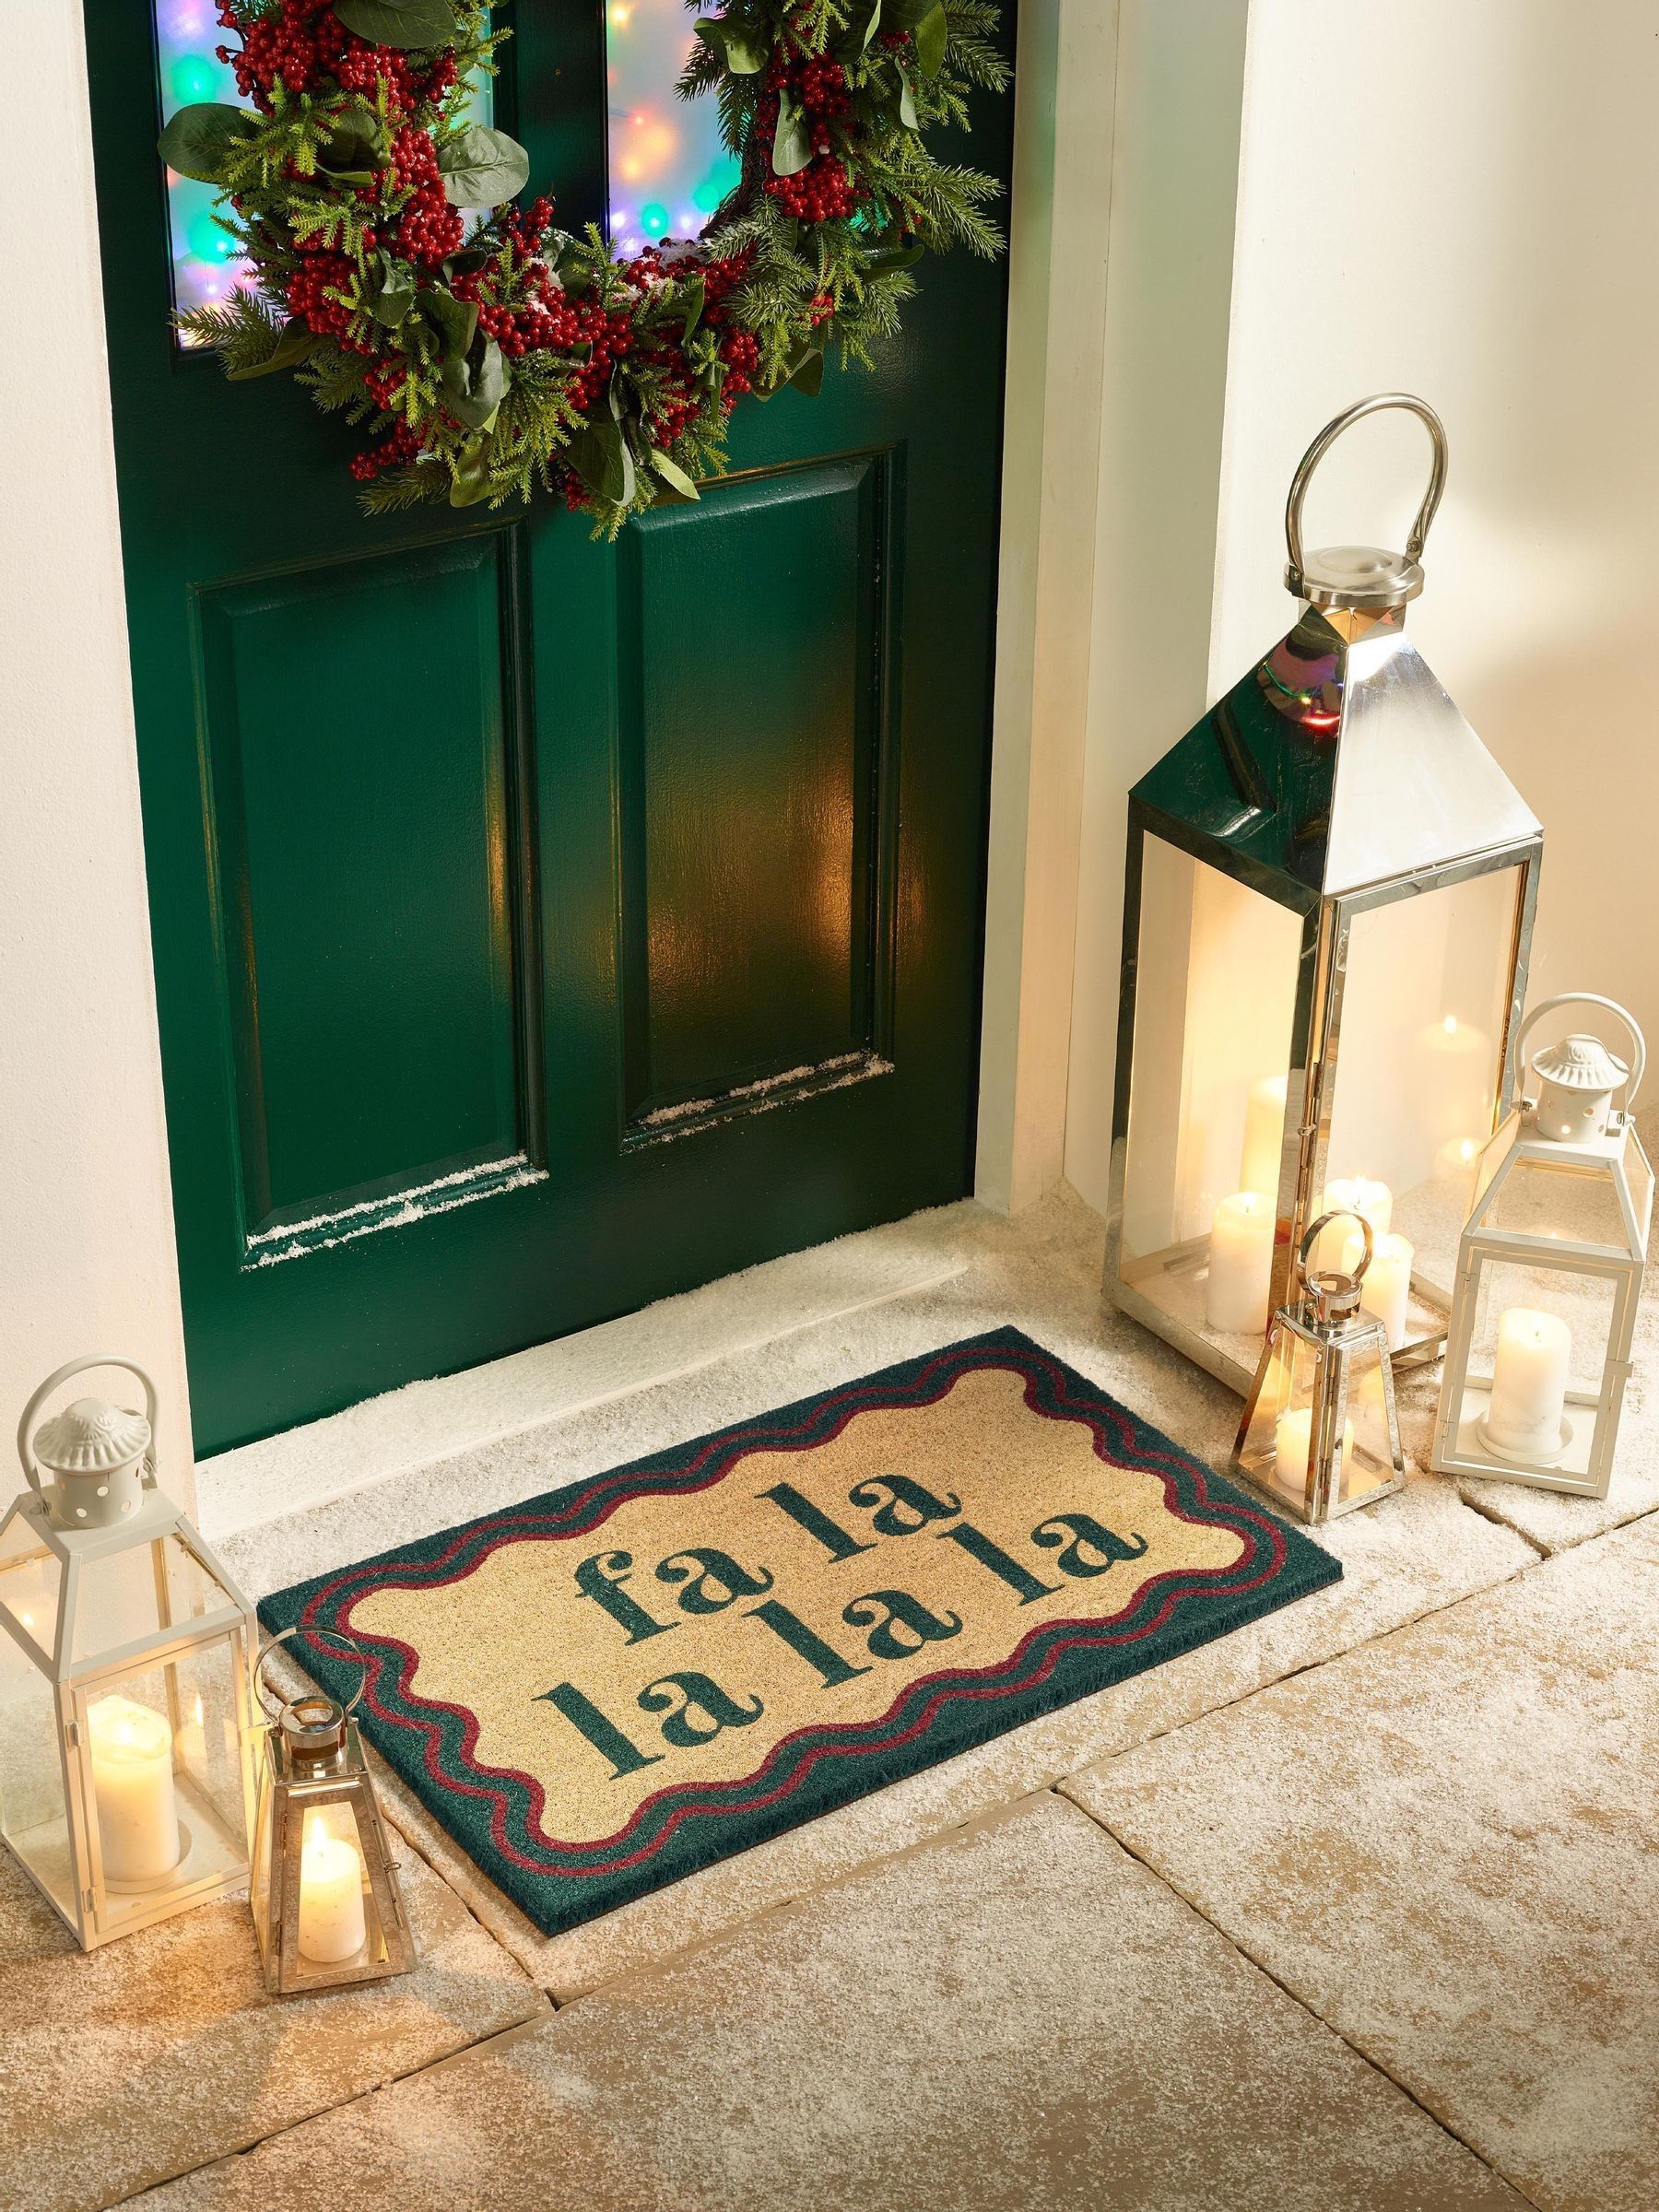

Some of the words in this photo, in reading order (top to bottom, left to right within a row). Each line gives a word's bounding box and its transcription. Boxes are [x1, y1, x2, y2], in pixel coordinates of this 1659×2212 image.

[531, 1671, 764, 1780] la
[741, 1589, 963, 1688] la
[935, 1512, 1148, 1606] la
[573, 1548, 774, 1646] fa
[754, 1474, 962, 1564] la
